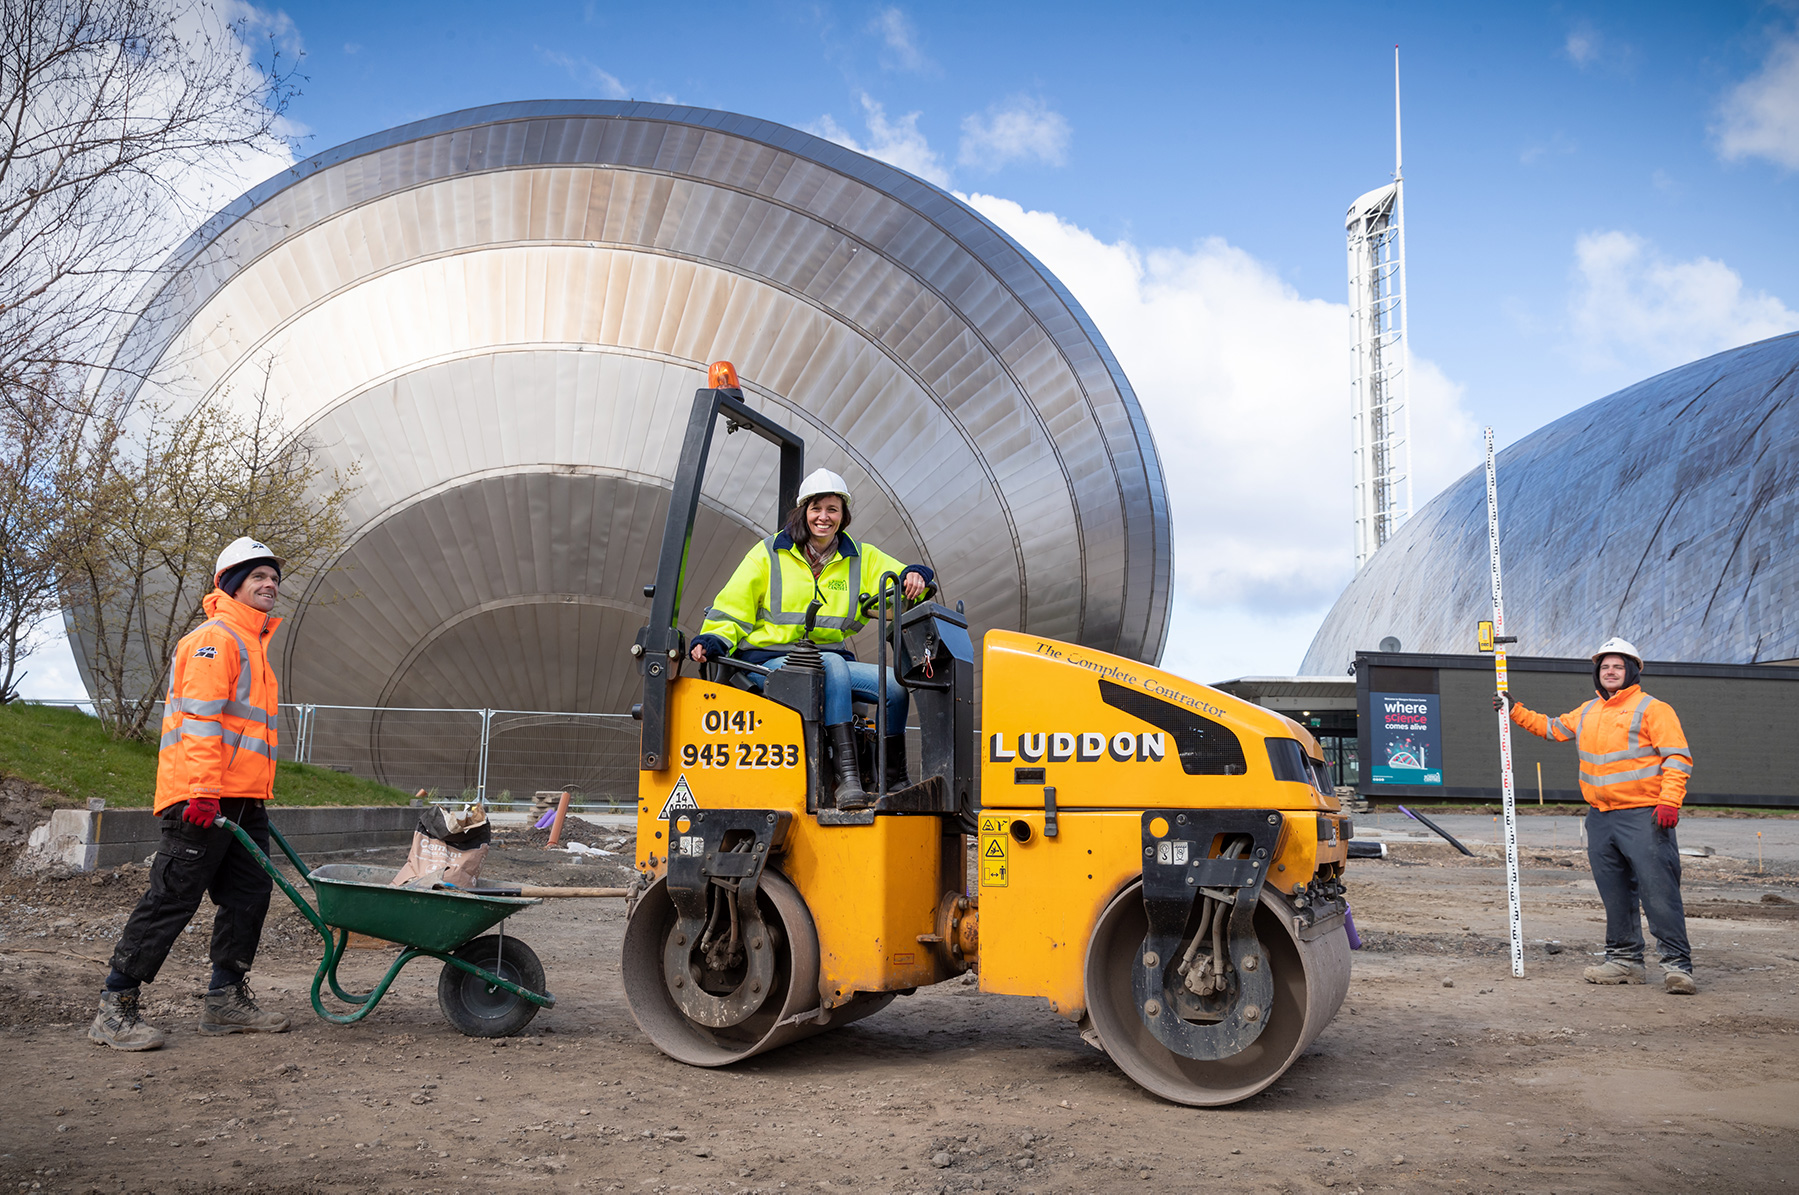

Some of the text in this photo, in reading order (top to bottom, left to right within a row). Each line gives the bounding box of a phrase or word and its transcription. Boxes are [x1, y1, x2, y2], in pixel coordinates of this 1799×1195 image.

[1035, 642, 1226, 718] The Complete Contractor
[1384, 701, 1427, 714] where
[1384, 713, 1427, 724] science
[1410, 723, 1427, 731] alive
[990, 732, 1165, 762] LUDDON
[680, 743, 799, 769] 945 2233
[676, 792, 688, 803] 14
